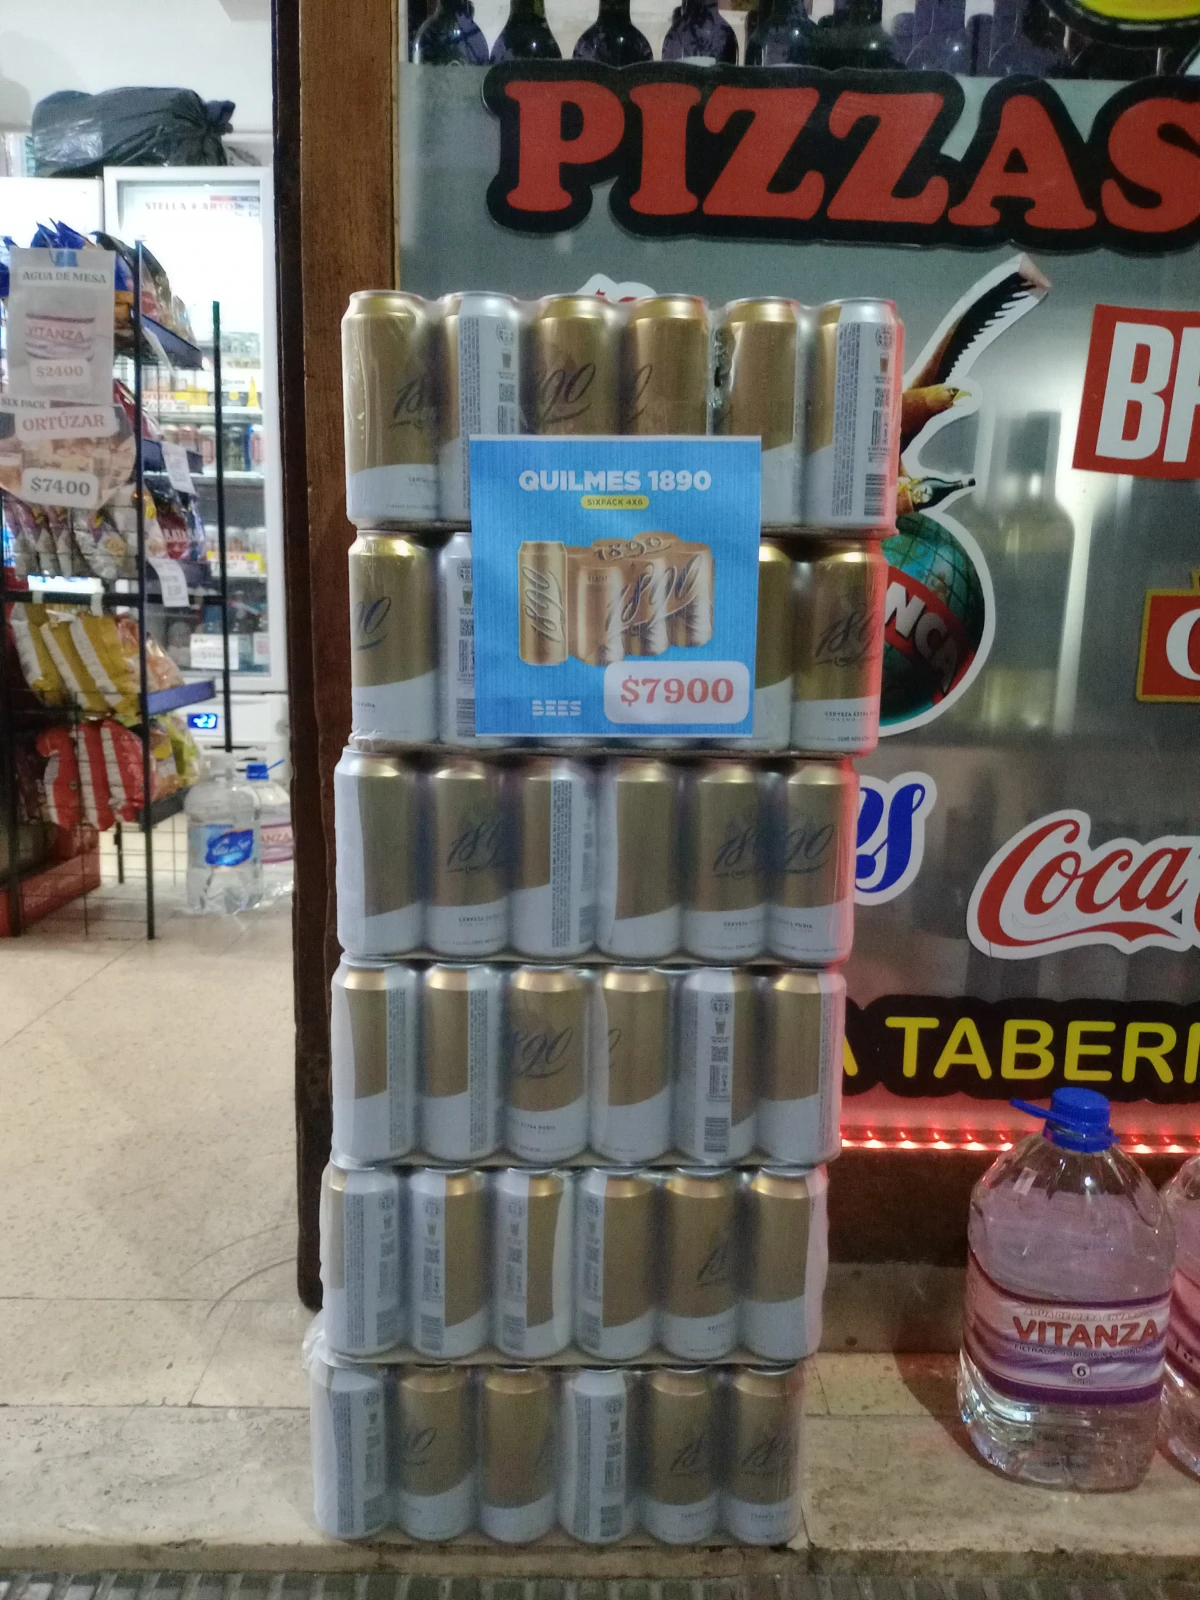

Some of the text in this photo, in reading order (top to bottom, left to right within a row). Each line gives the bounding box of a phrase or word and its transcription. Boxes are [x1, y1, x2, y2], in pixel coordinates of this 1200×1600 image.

[504, 80, 1200, 233] PIZZAS
[23, 271, 107, 283] AGUA DE MESA
[36, 365, 84, 377] $2400
[22, 411, 106, 431] ORTÚZAR
[30, 477, 91, 496] $7400
[519, 470, 712, 492] QUILMES 1890
[587, 498, 643, 506] SIXPACK 4X6
[620, 675, 734, 706] $7900
[532, 700, 581, 716] BEES
[977, 819, 1193, 947] Coca
[1013, 1315, 1159, 1349] VITANZA
[1076, 1365, 1086, 1378] 6
